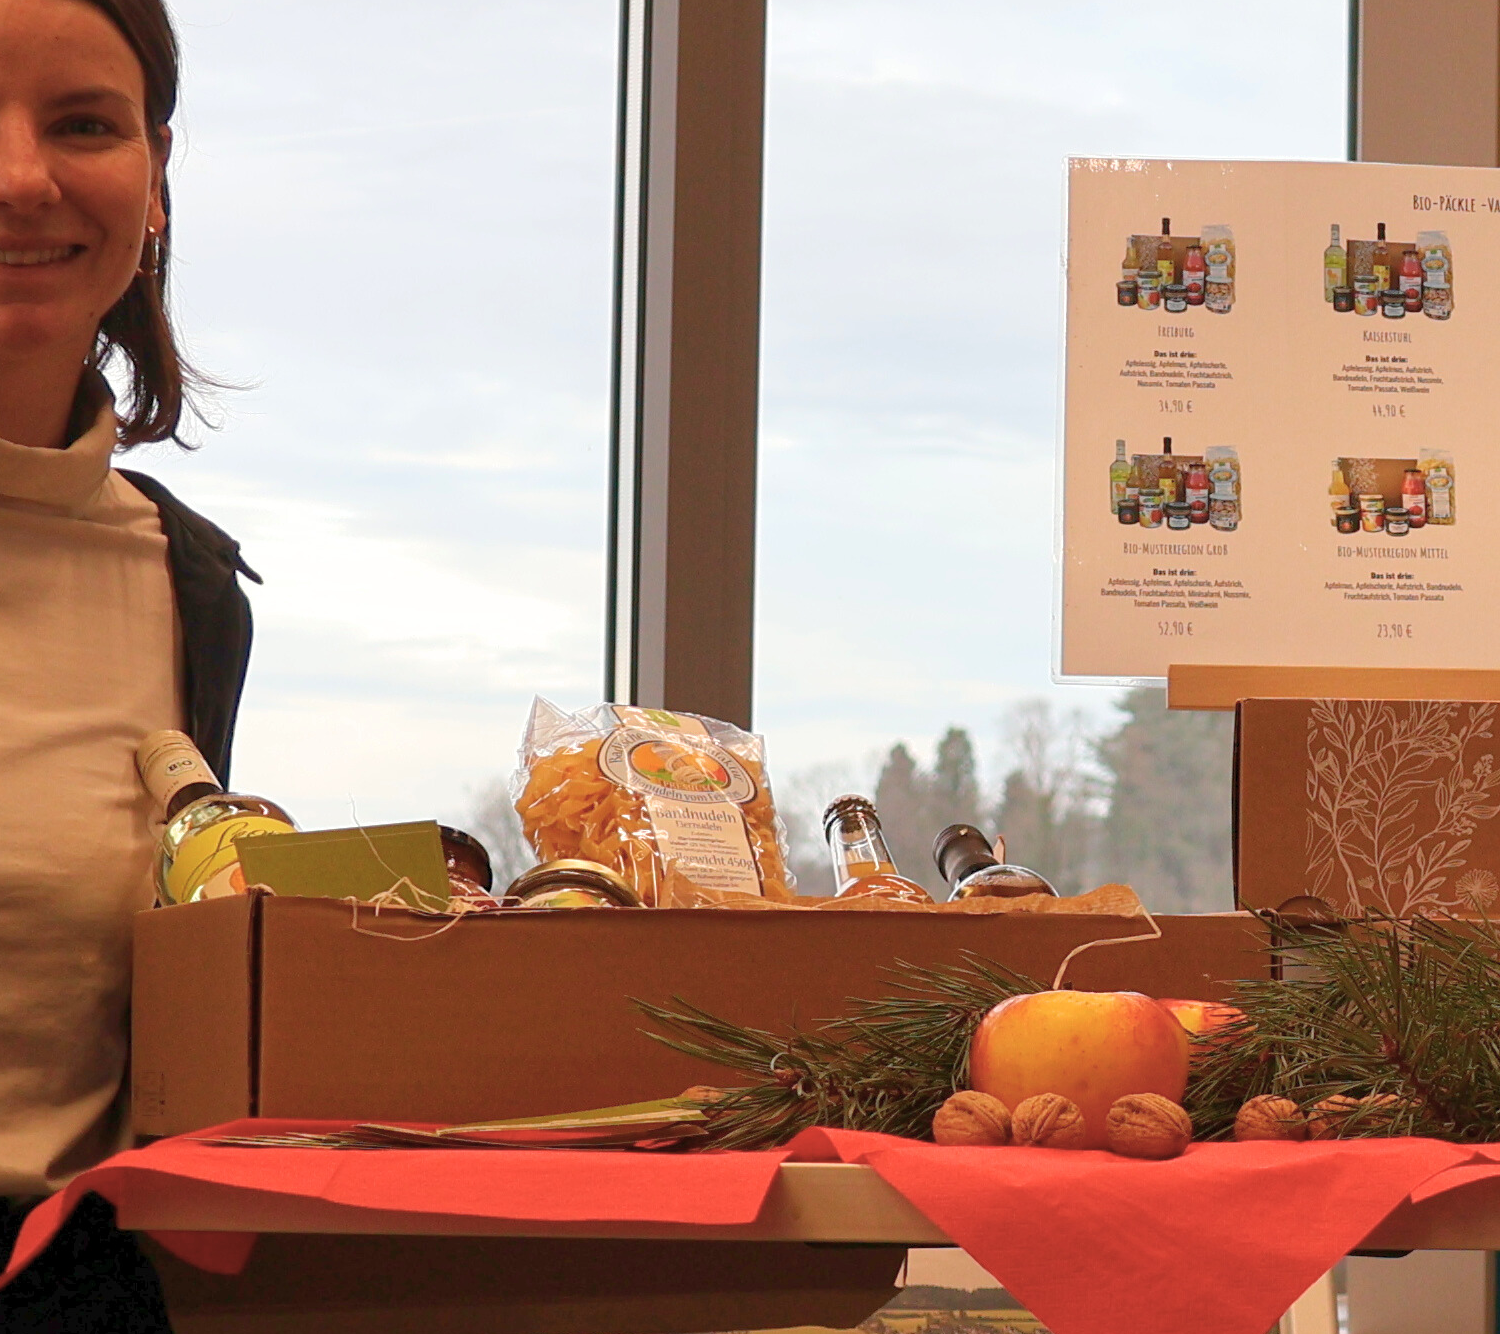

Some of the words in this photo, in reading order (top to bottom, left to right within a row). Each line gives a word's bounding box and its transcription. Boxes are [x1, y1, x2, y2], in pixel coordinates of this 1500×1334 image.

[1365, 355, 1378, 363] Das
[1380, 355, 1389, 363] ist
[1186, 401, 1193, 412] €
[1400, 405, 1406, 417] €
[1153, 568, 1166, 576] Das
[1168, 568, 1177, 576] ist
[1187, 622, 1194, 635] €
[1406, 625, 1413, 638] €
[684, 793, 708, 803] vom
[656, 808, 736, 823] Bandnudeln
[727, 858, 754, 870] 450g
